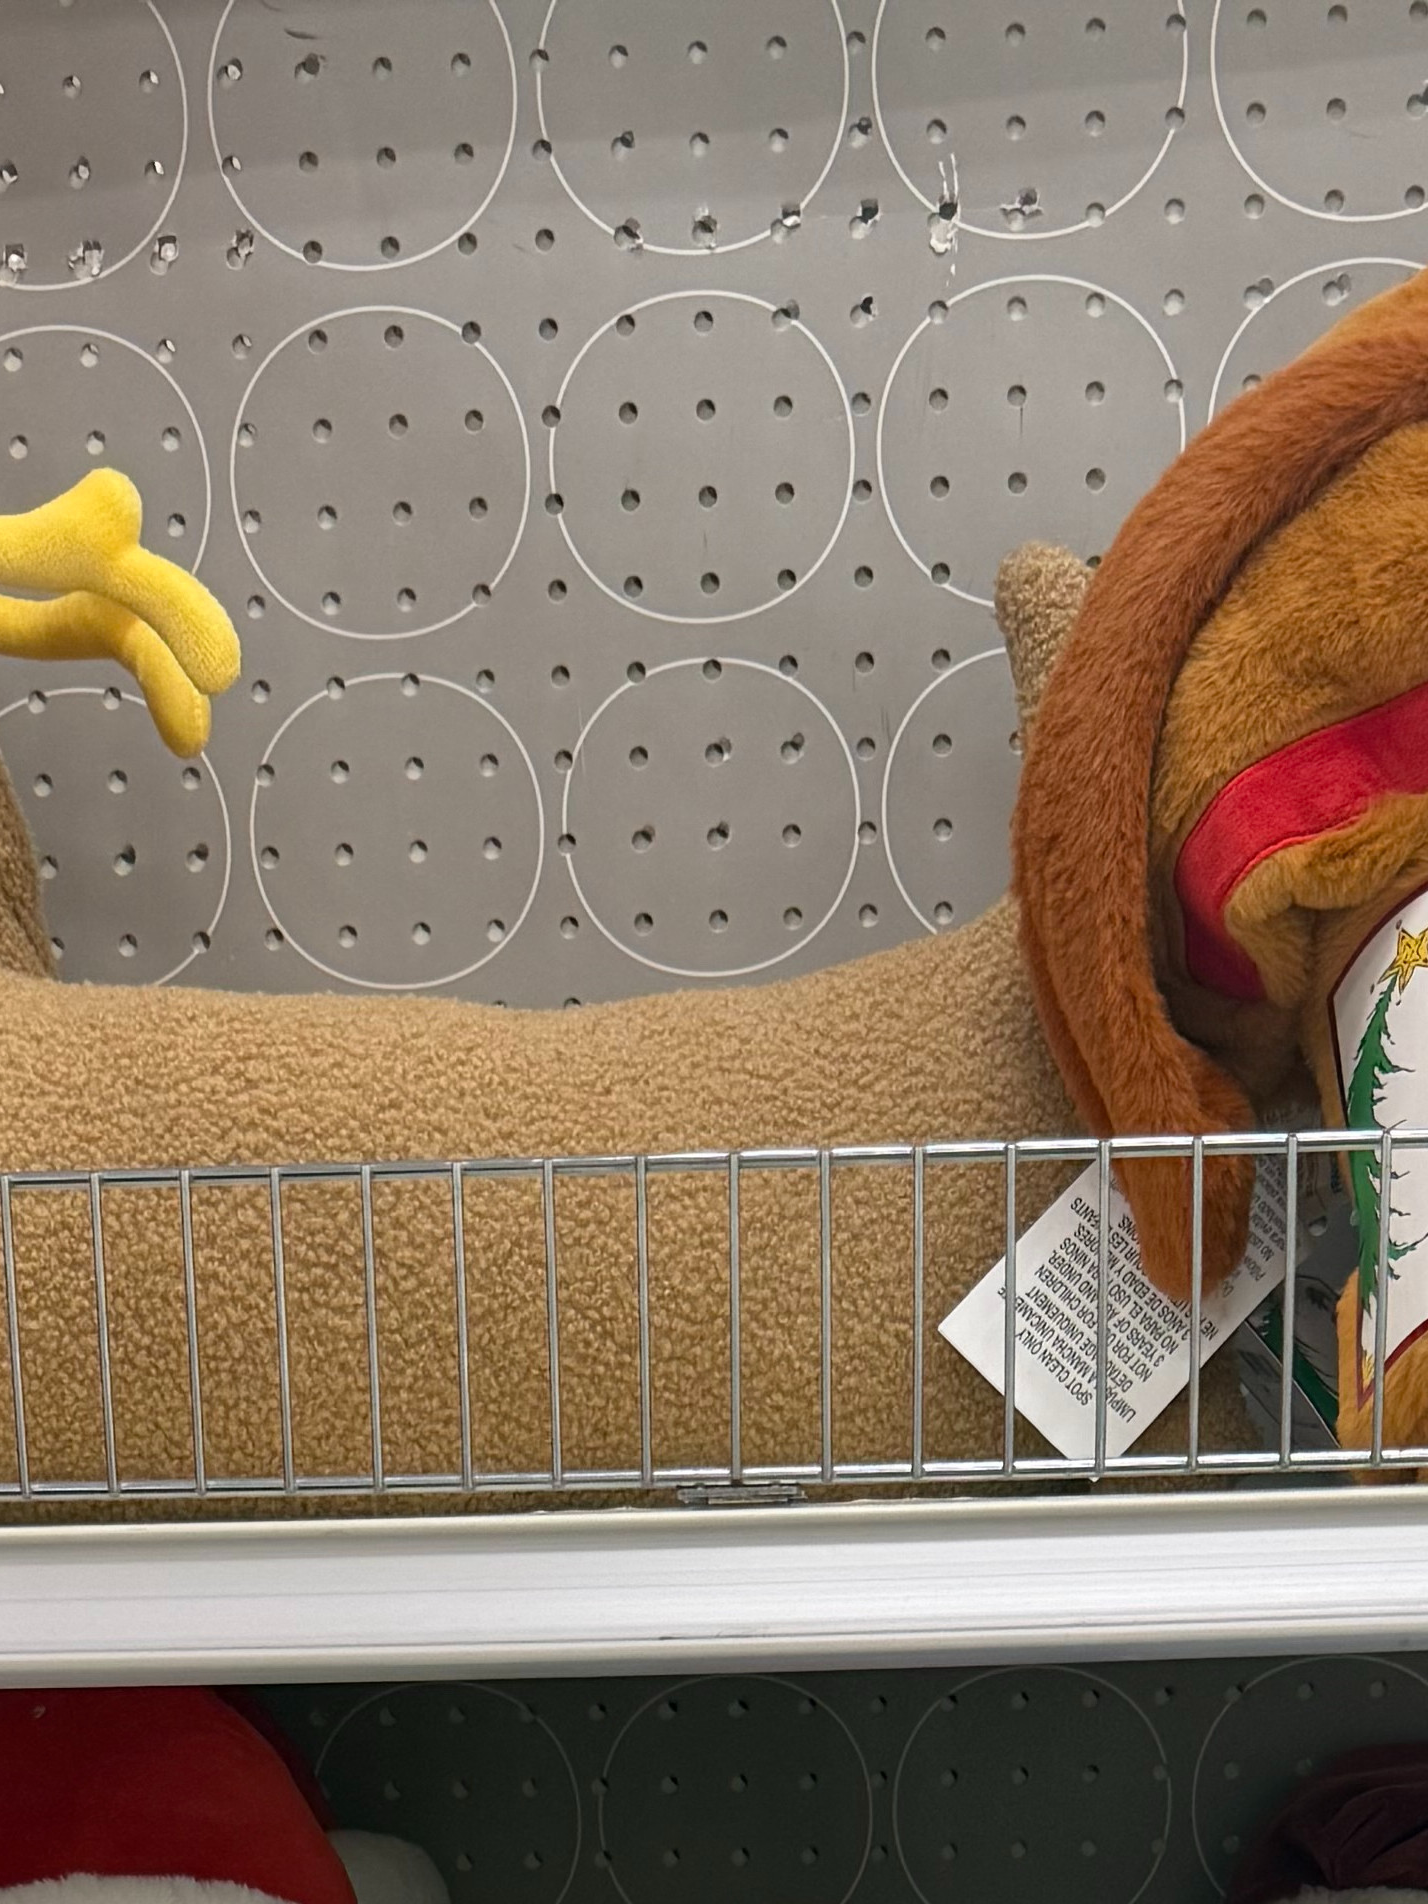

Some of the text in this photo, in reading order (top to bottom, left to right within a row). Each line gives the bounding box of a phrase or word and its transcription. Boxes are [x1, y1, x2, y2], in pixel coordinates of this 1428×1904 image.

[1121, 1270, 1150, 1300] EDAD
[1026, 1283, 1085, 1346] UNIQUEMENT
[1034, 1263, 1153, 1382] NOT FOR CHILDREN
[1113, 1316, 1132, 1335] OF
[1137, 1313, 1165, 1341] PARA
[1125, 1327, 1159, 1362] YEARS
[1160, 1335, 1179, 1354] NO
[1015, 1327, 1094, 1406] SPOT CLEAN ONLY
